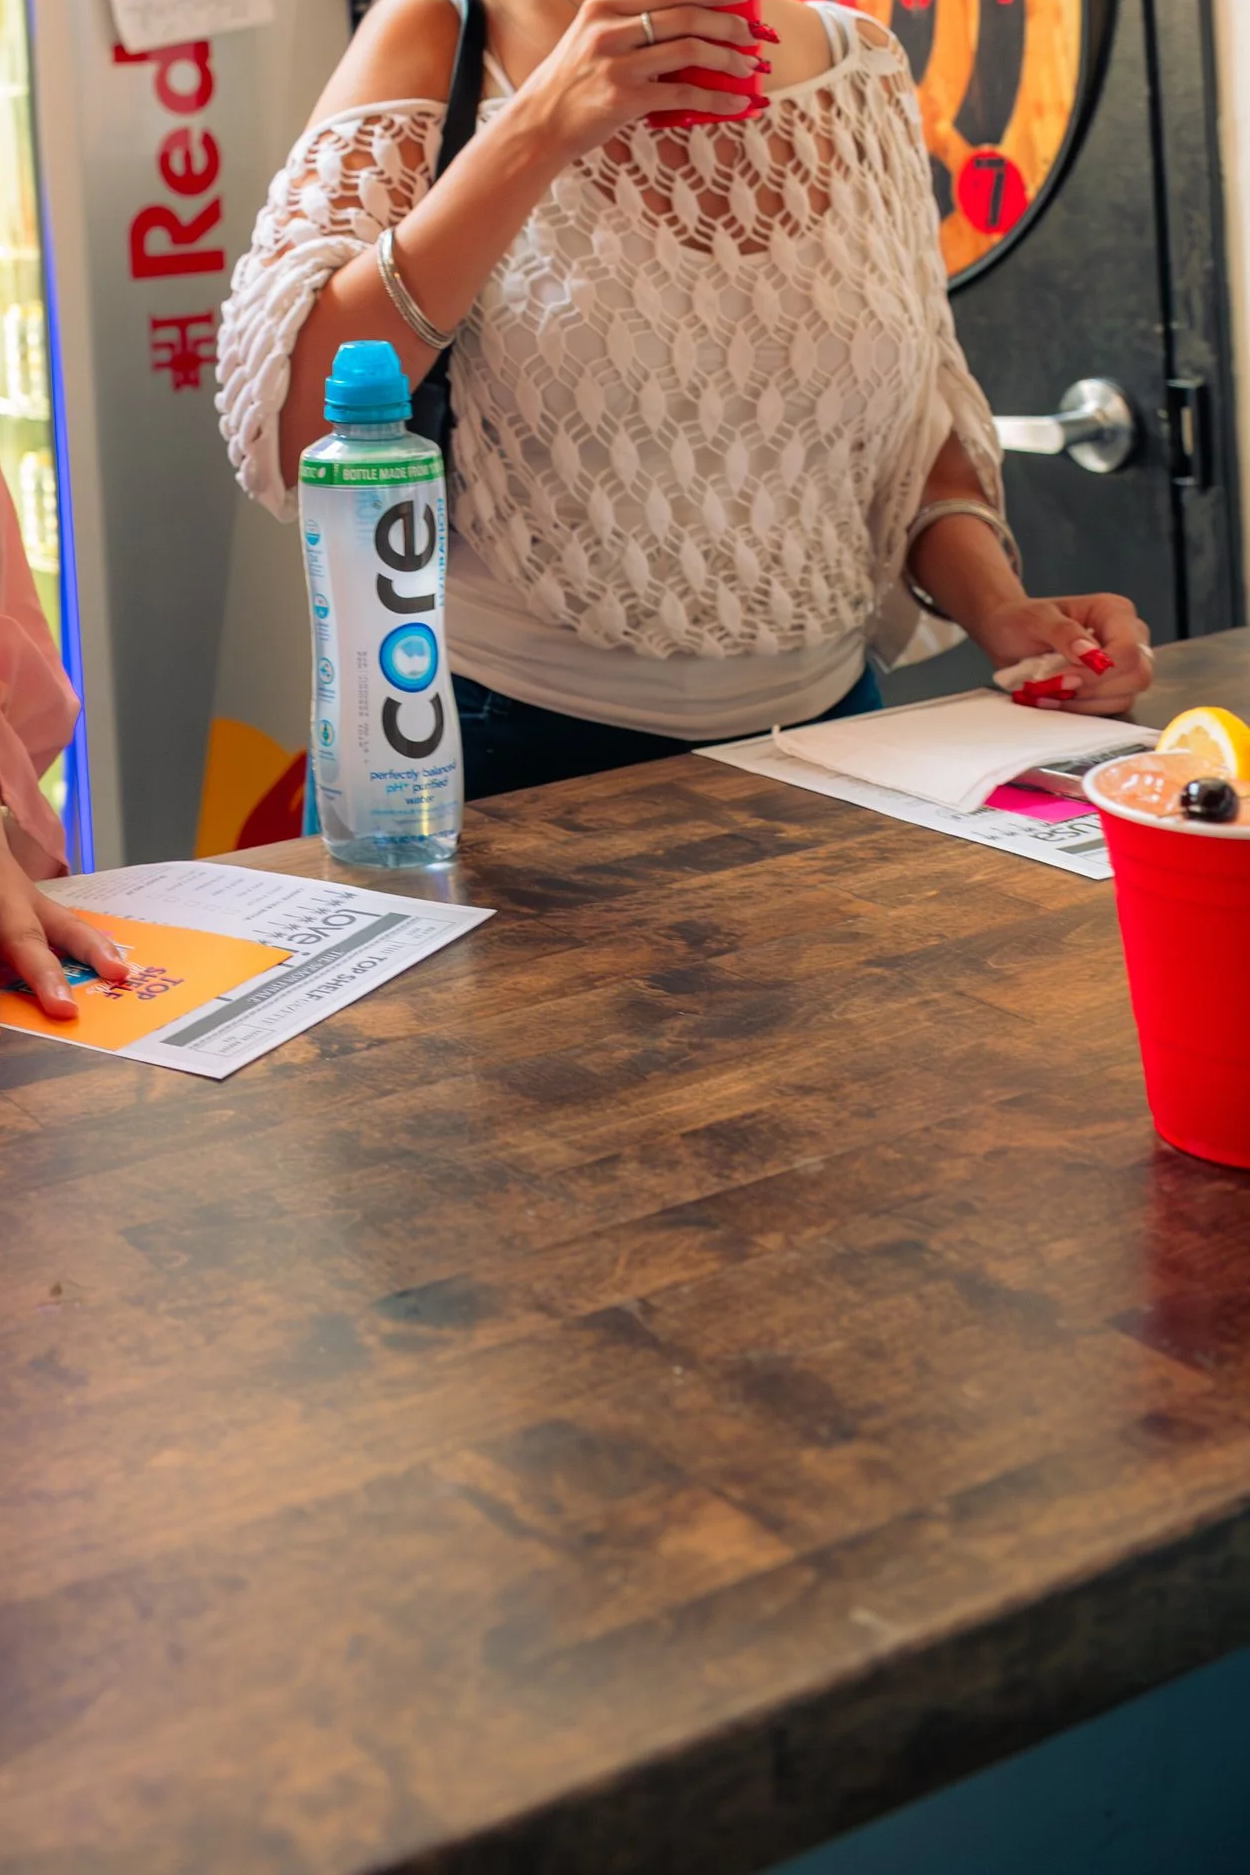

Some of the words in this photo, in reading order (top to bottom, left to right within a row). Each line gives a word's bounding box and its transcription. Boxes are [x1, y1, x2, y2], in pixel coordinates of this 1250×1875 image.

[113, 39, 225, 280] Red
[975, 157, 1005, 228] 7
[343, 468, 377, 480] BOTTLE
[379, 467, 407, 479] MADE
[375, 500, 443, 759] core
[370, 769, 418, 781] perfectly
[288, 909, 381, 946] love
[353, 956, 387, 974] TOP
[136, 976, 185, 1000] TOP
[305, 974, 356, 1000] SHELF
